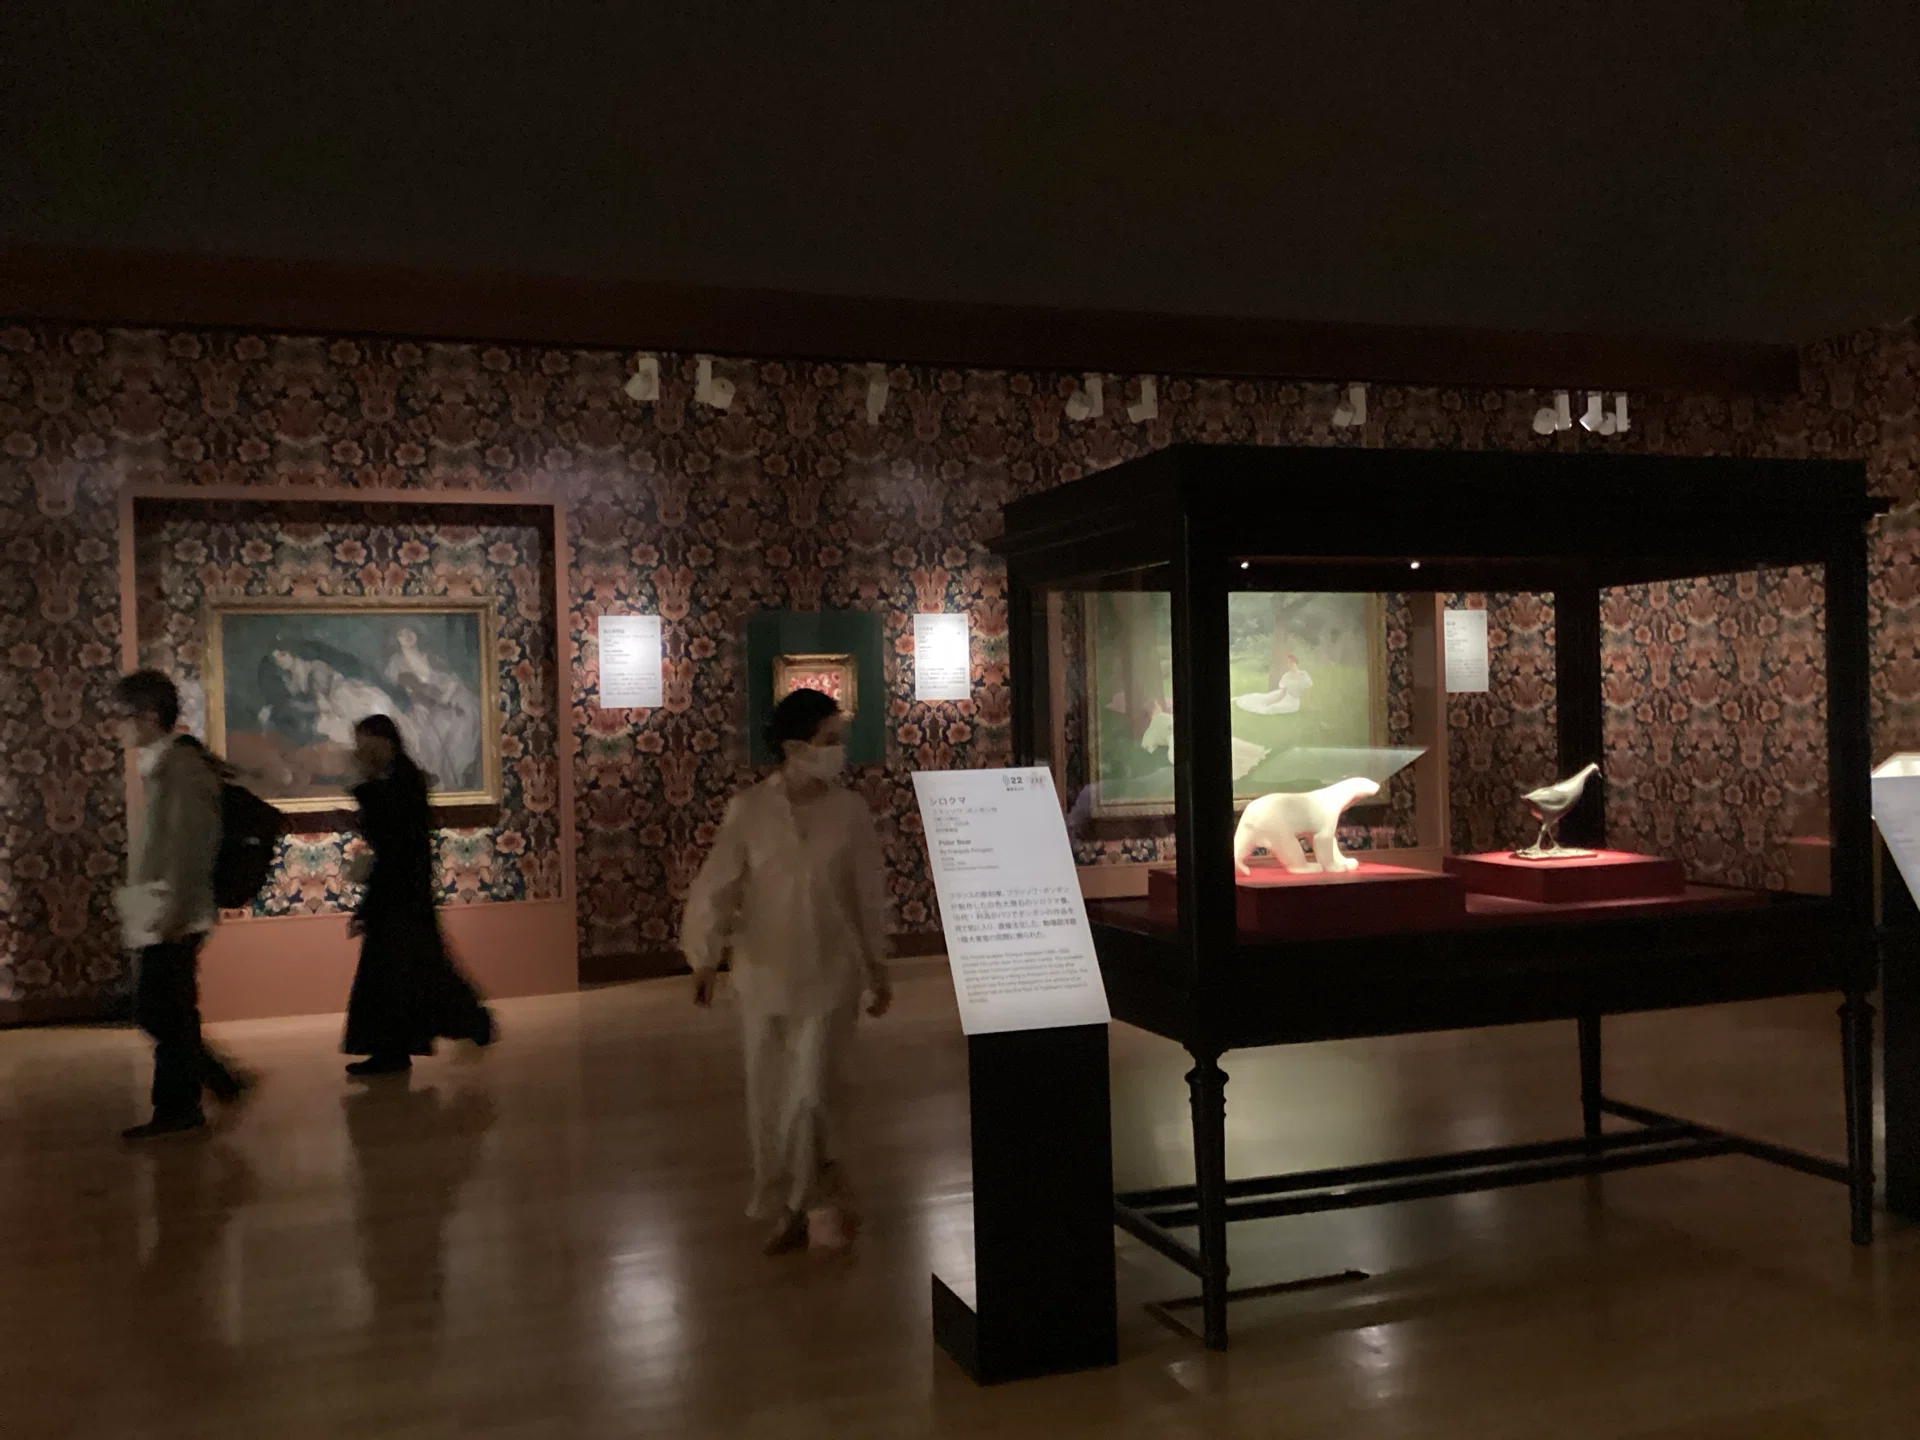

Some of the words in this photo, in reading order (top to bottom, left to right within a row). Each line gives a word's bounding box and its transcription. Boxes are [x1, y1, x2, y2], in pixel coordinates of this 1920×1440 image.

[1010, 776, 1023, 784] 22
[929, 796, 966, 806] シロクマ
